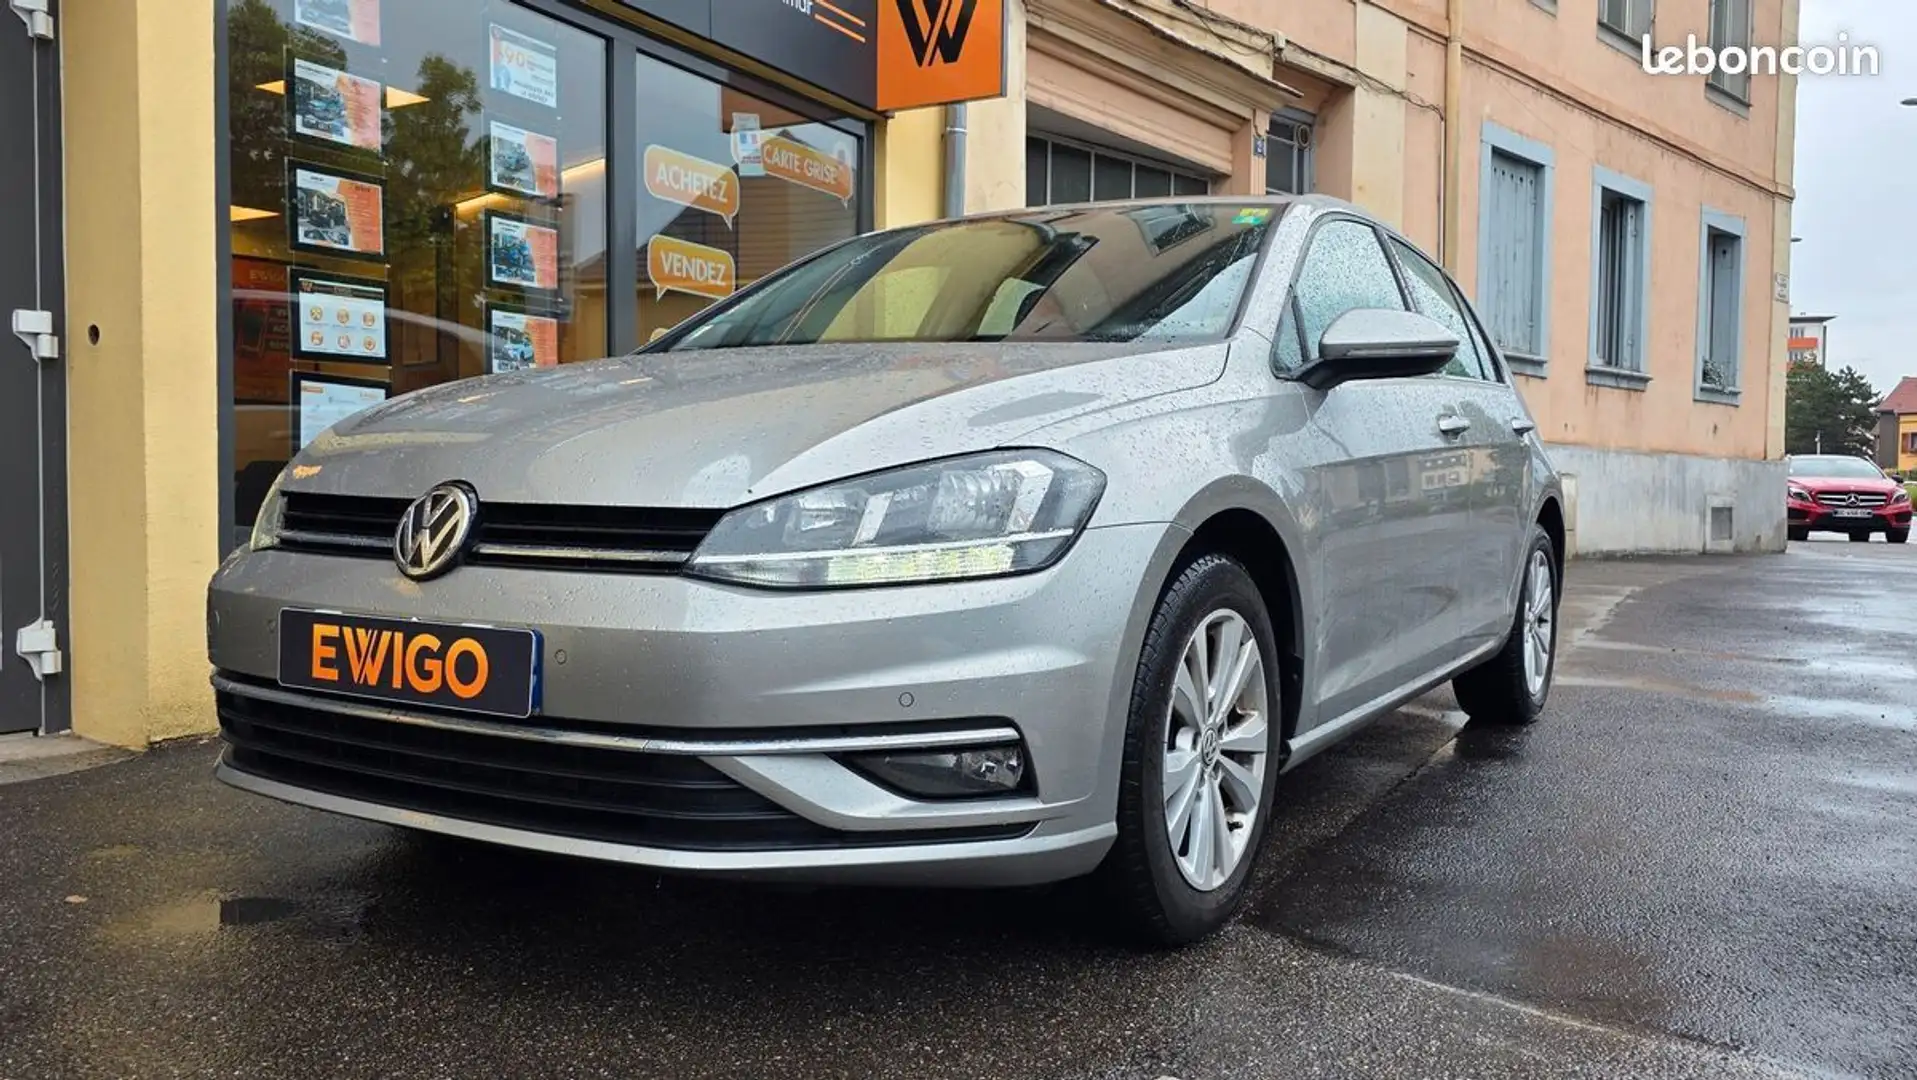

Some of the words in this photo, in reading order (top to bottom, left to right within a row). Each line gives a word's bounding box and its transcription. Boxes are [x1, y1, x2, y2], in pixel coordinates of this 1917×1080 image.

[656, 164, 728, 203] ACHETEZ
[763, 145, 802, 173] CARTE
[803, 158, 838, 185] GRISE
[660, 252, 726, 286] VENDEZ
[311, 623, 489, 699] EWIGO
